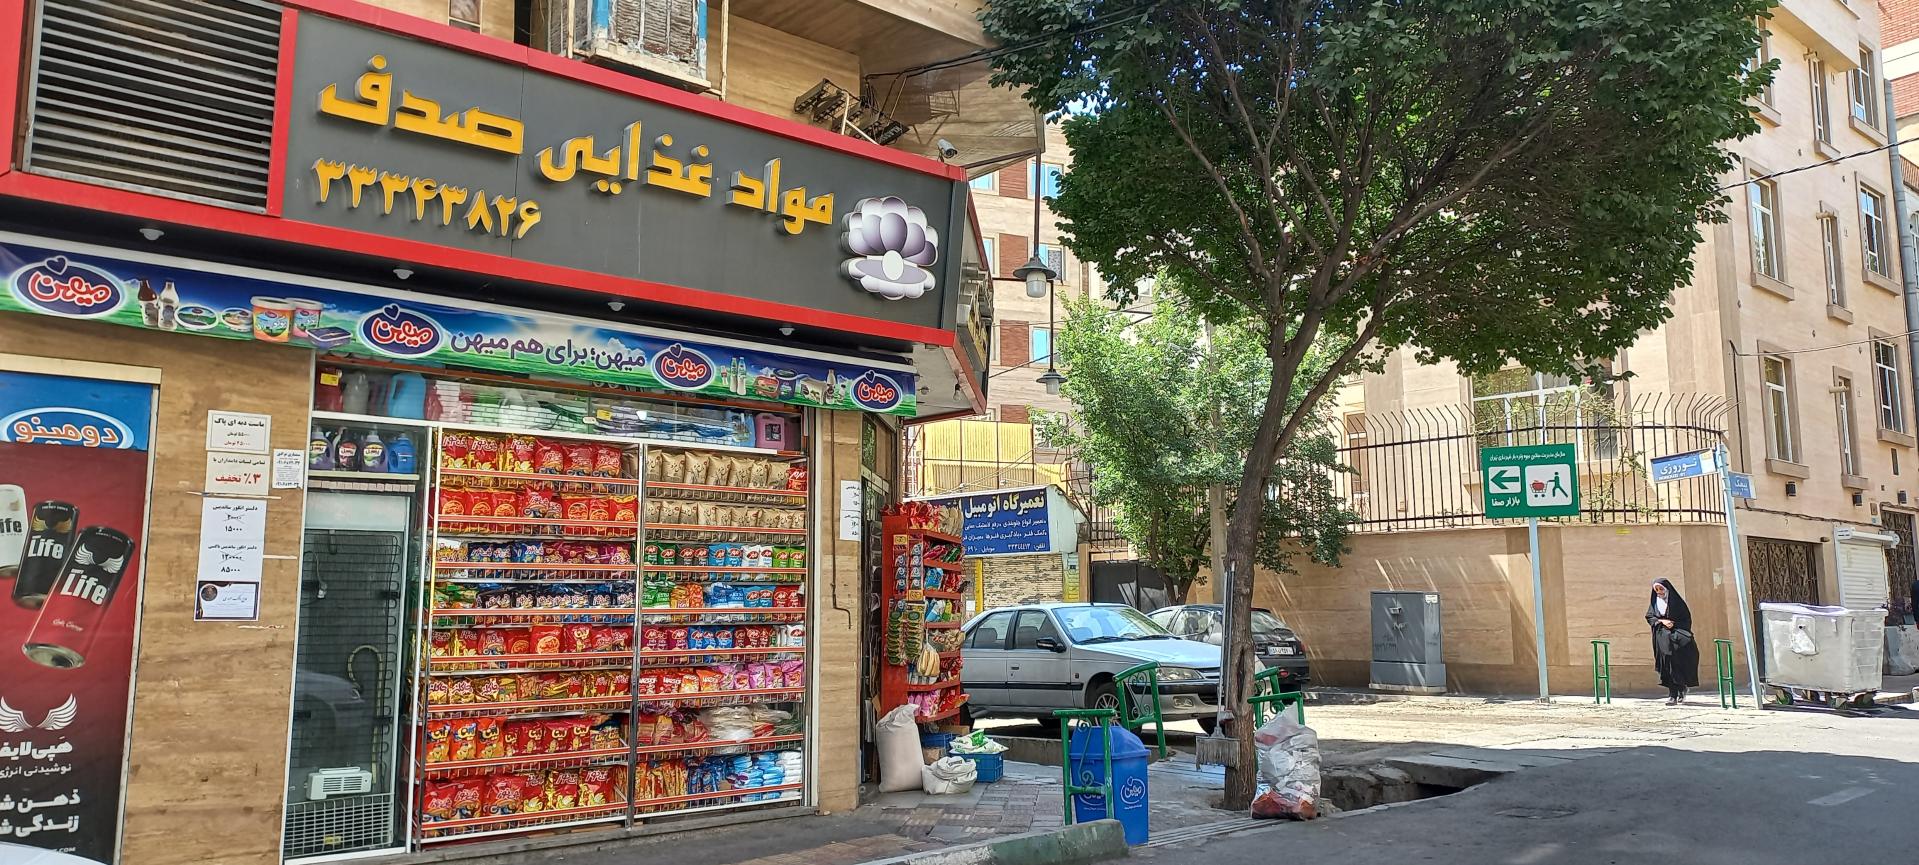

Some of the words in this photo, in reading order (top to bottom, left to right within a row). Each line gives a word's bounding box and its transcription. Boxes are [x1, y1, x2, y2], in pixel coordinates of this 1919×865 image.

[318, 54, 525, 155] صدف
[537, 120, 712, 198] غذایی
[312, 157, 542, 241] ۳۳۳۴۳۸۲۶
[728, 157, 834, 236] مواد
[28, 272, 112, 306] میهن
[371, 317, 433, 348] میهن
[451, 331, 509, 354] میهن
[510, 337, 544, 359] هم
[546, 340, 588, 367] برای
[661, 357, 708, 380] میهن
[14, 417, 119, 446] دومینو
[1660, 457, 1697, 475] نوروزی
[215, 474, 241, 484] تخفیف
[964, 494, 1000, 519] اتومبیل
[1003, 491, 1045, 516] تعمیرگاه
[1491, 498, 1504, 506] صفا
[1505, 496, 1520, 507] بازار
[0, 518, 22, 533] ife
[28, 537, 64, 560] Life
[60, 573, 107, 605] Life
[24, 763, 72, 777] نوشیدنی
[18, 789, 80, 813] ذهن
[15, 814, 79, 837] زندگی
